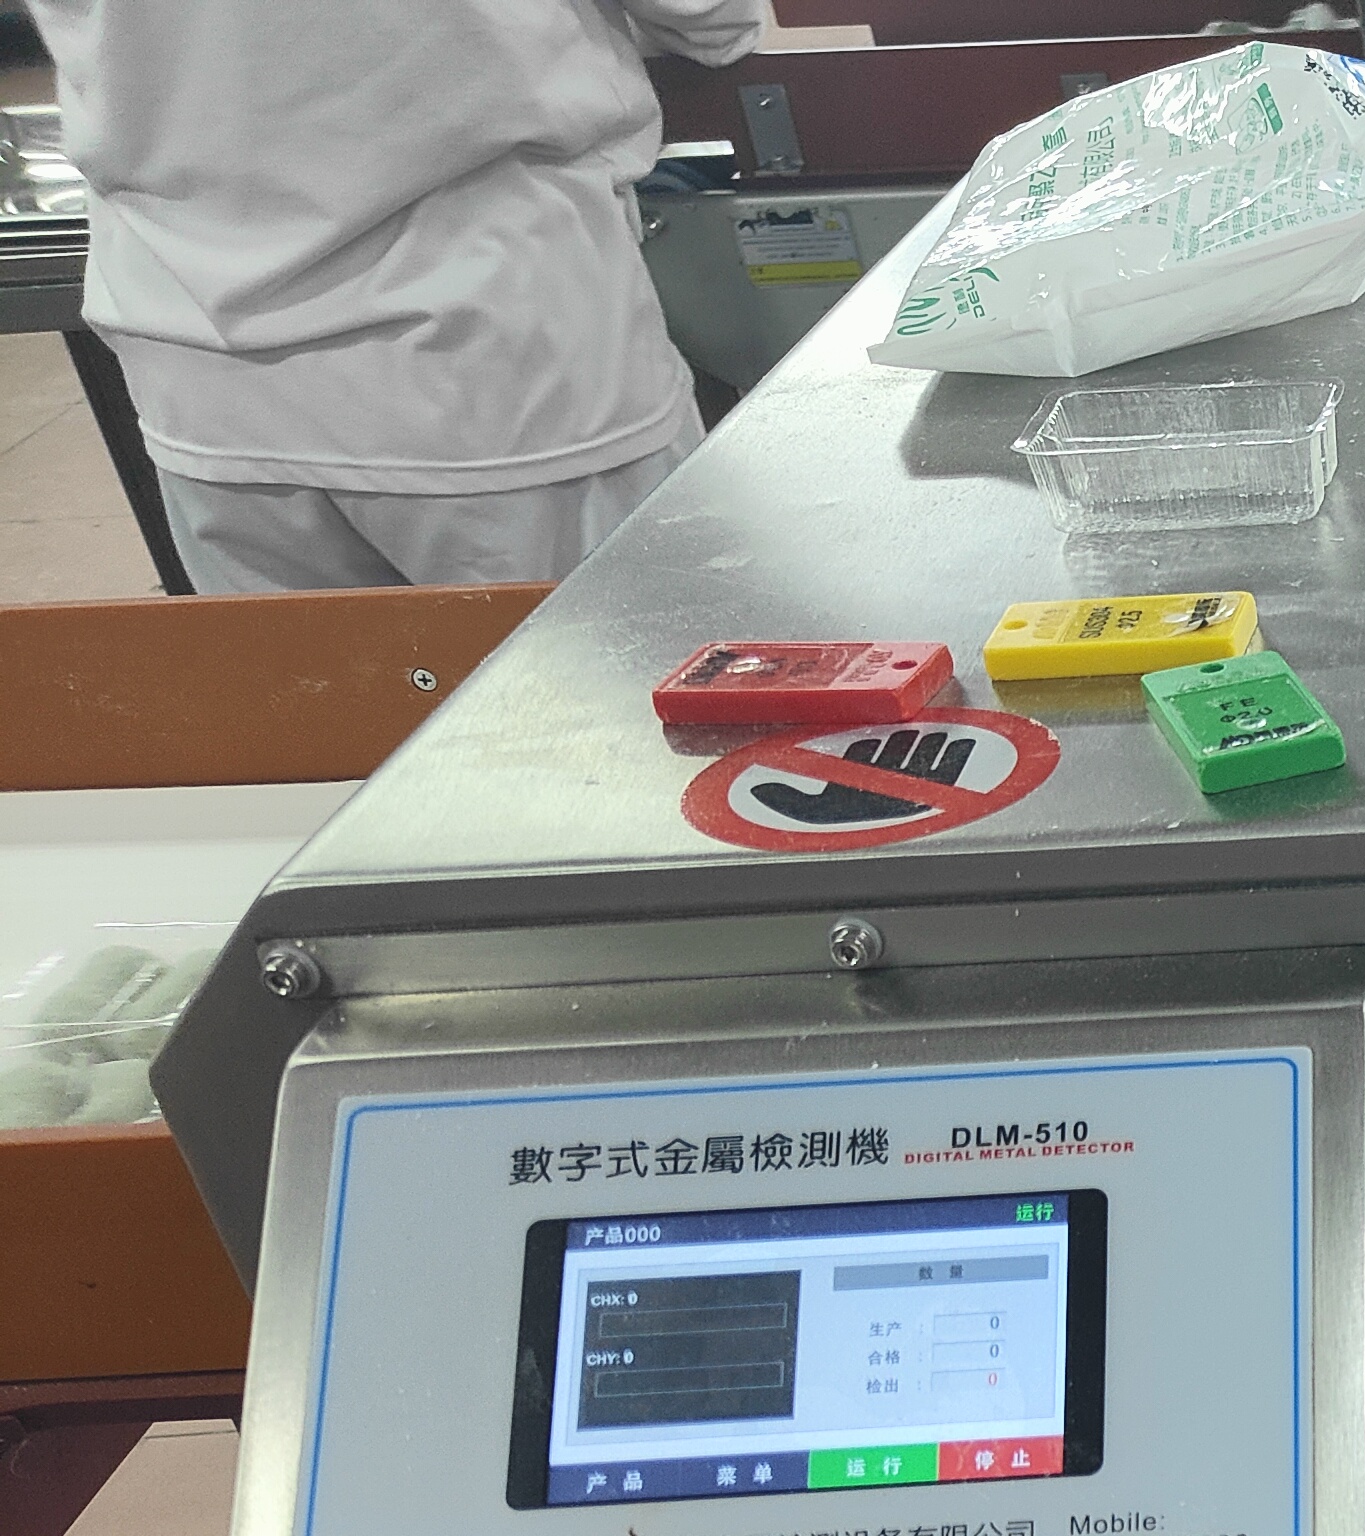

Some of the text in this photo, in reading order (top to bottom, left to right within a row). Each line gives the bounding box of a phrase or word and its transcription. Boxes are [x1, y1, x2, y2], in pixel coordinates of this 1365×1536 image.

[963, 276, 985, 318] DELI
[1078, 605, 1114, 639] SUS304
[951, 1120, 1089, 1149] DLM-510
[508, 1127, 889, 1186] 數字式金屬檢測機
[904, 1141, 1135, 1165] DIGITAL METAL DETECTOR
[1015, 1203, 1055, 1222] 运行
[585, 1225, 661, 1246] 产品000
[990, 1316, 1000, 1330] 0
[989, 1344, 999, 1358] 0
[988, 1372, 998, 1386] 0
[846, 1457, 903, 1477] 运行
[975, 1449, 1031, 1470] 停止
[585, 1470, 644, 1494] 产品
[716, 1461, 774, 1486] 菜单
[1069, 1512, 1165, 1536] Mobile:
